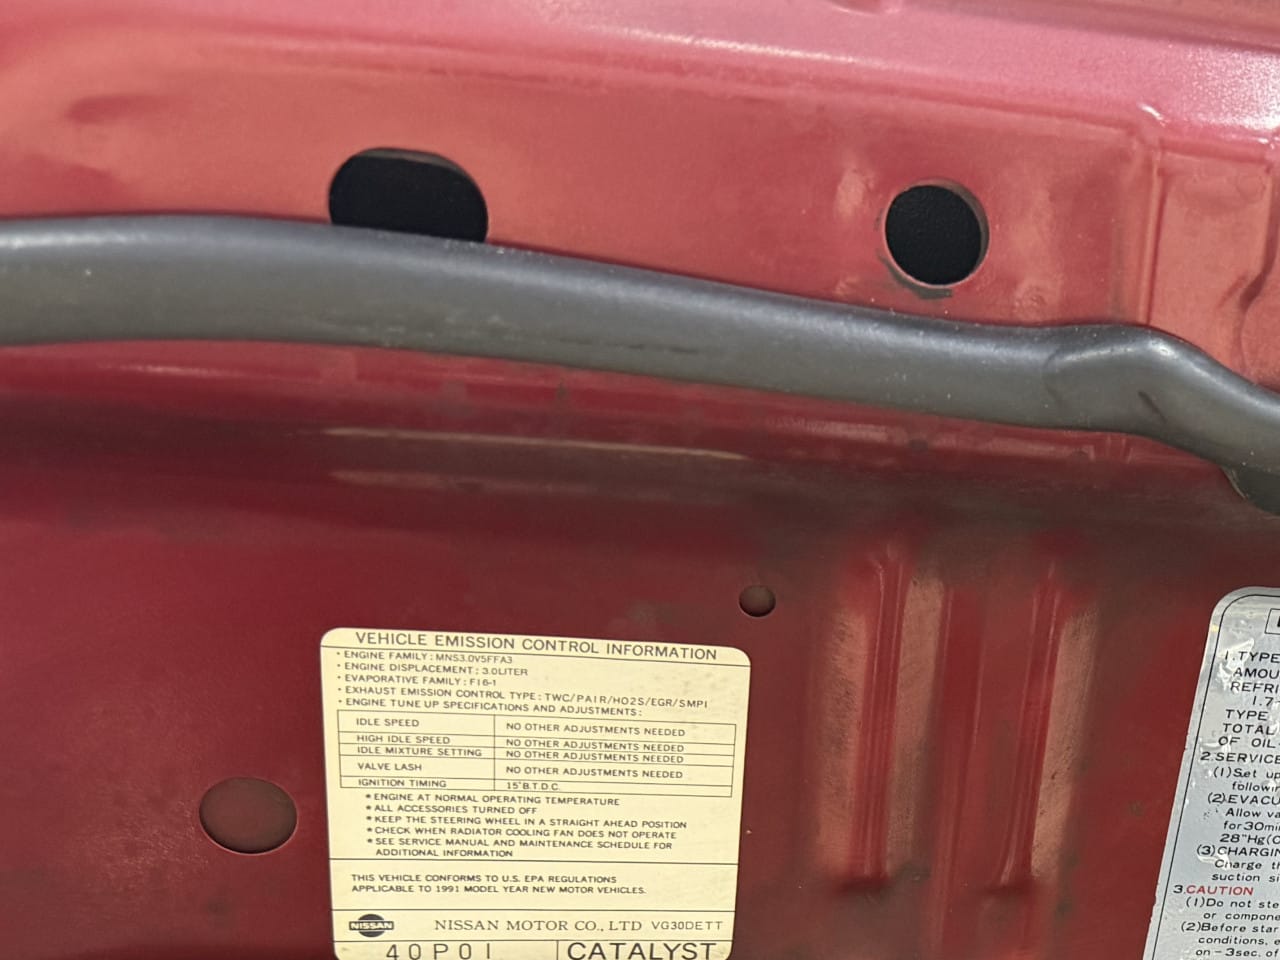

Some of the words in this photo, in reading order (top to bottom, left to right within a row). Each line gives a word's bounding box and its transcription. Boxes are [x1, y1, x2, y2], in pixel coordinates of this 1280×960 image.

[356, 631, 428, 646] VEHICLE
[435, 634, 515, 649] EMISSION
[522, 638, 599, 654] CONTROL
[607, 643, 717, 660] INFORMATION
[344, 651, 385, 660] ENGINE
[344, 662, 385, 672] ENGINE
[345, 674, 419, 684] EVAPORATIVE
[345, 686, 396, 695] EXHAUST
[400, 688, 451, 697] EMISSION
[456, 690, 505, 699] CONTROL
[346, 698, 385, 707] ENGINE
[391, 700, 421, 708] TUNE
[424, 700, 439, 709] UP
[443, 701, 529, 712] SPECIFICATIONS
[533, 705, 555, 713] AND
[1226, 709, 1268, 721] TYPE
[356, 718, 380, 727] IDLE
[384, 718, 420, 728] SPEED
[506, 723, 521, 731] NO
[525, 723, 560, 732] OTHER
[564, 724, 640, 736] ADJUSTMENTS
[644, 727, 686, 737] NEEDED
[1222, 723, 1276, 736] TOTAL
[357, 735, 383, 743] HIGH
[387, 735, 411, 744] IDLE
[415, 736, 450, 745] SPEED
[357, 746, 381, 754] IDLE
[385, 747, 433, 756] MIXTURE
[437, 748, 482, 757] SETTING
[357, 762, 390, 771] VALVE
[394, 763, 422, 771] LASH
[358, 778, 405, 787] IGNITION
[409, 779, 447, 788] TIMING
[374, 793, 413, 801] ENGINE
[435, 794, 478, 803] NORMAL
[482, 795, 541, 804] OPERATING
[545, 796, 620, 806] TEMPERATURE
[397, 805, 468, 813] ACCESSORIES
[472, 806, 515, 815] TURNED
[519, 807, 538, 815] OFF
[376, 849, 439, 857] ADDITIONAL
[443, 849, 513, 857] INFORMATION
[351, 874, 375, 882] THIS
[378, 874, 421, 882] VEHICLE
[425, 874, 482, 883] CONFORMS
[486, 875, 499, 883] TO
[501, 875, 521, 883] U.S.
[524, 875, 544, 883] EPA
[548, 875, 617, 884] REGULATIONS
[1211, 872, 1261, 882] suction
[351, 885, 414, 893] APPLICABLE
[436, 885, 460, 893] 1991
[464, 886, 499, 894] MODEL
[502, 886, 529, 894] YEAR
[532, 886, 556, 894] NEW
[559, 886, 594, 894] MOTOR
[597, 886, 647, 895] VEHICLES.
[1230, 899, 1251, 908] not
[1203, 912, 1217, 920] or
[350, 922, 393, 930] NISSAN
[434, 920, 499, 930] NISSAN
[506, 920, 568, 931] MOTOR
[574, 920, 604, 932] CO.,
[609, 920, 642, 931] LTD
[651, 921, 723, 930] VG30DETT
[567, 942, 717, 960] CATALYST
